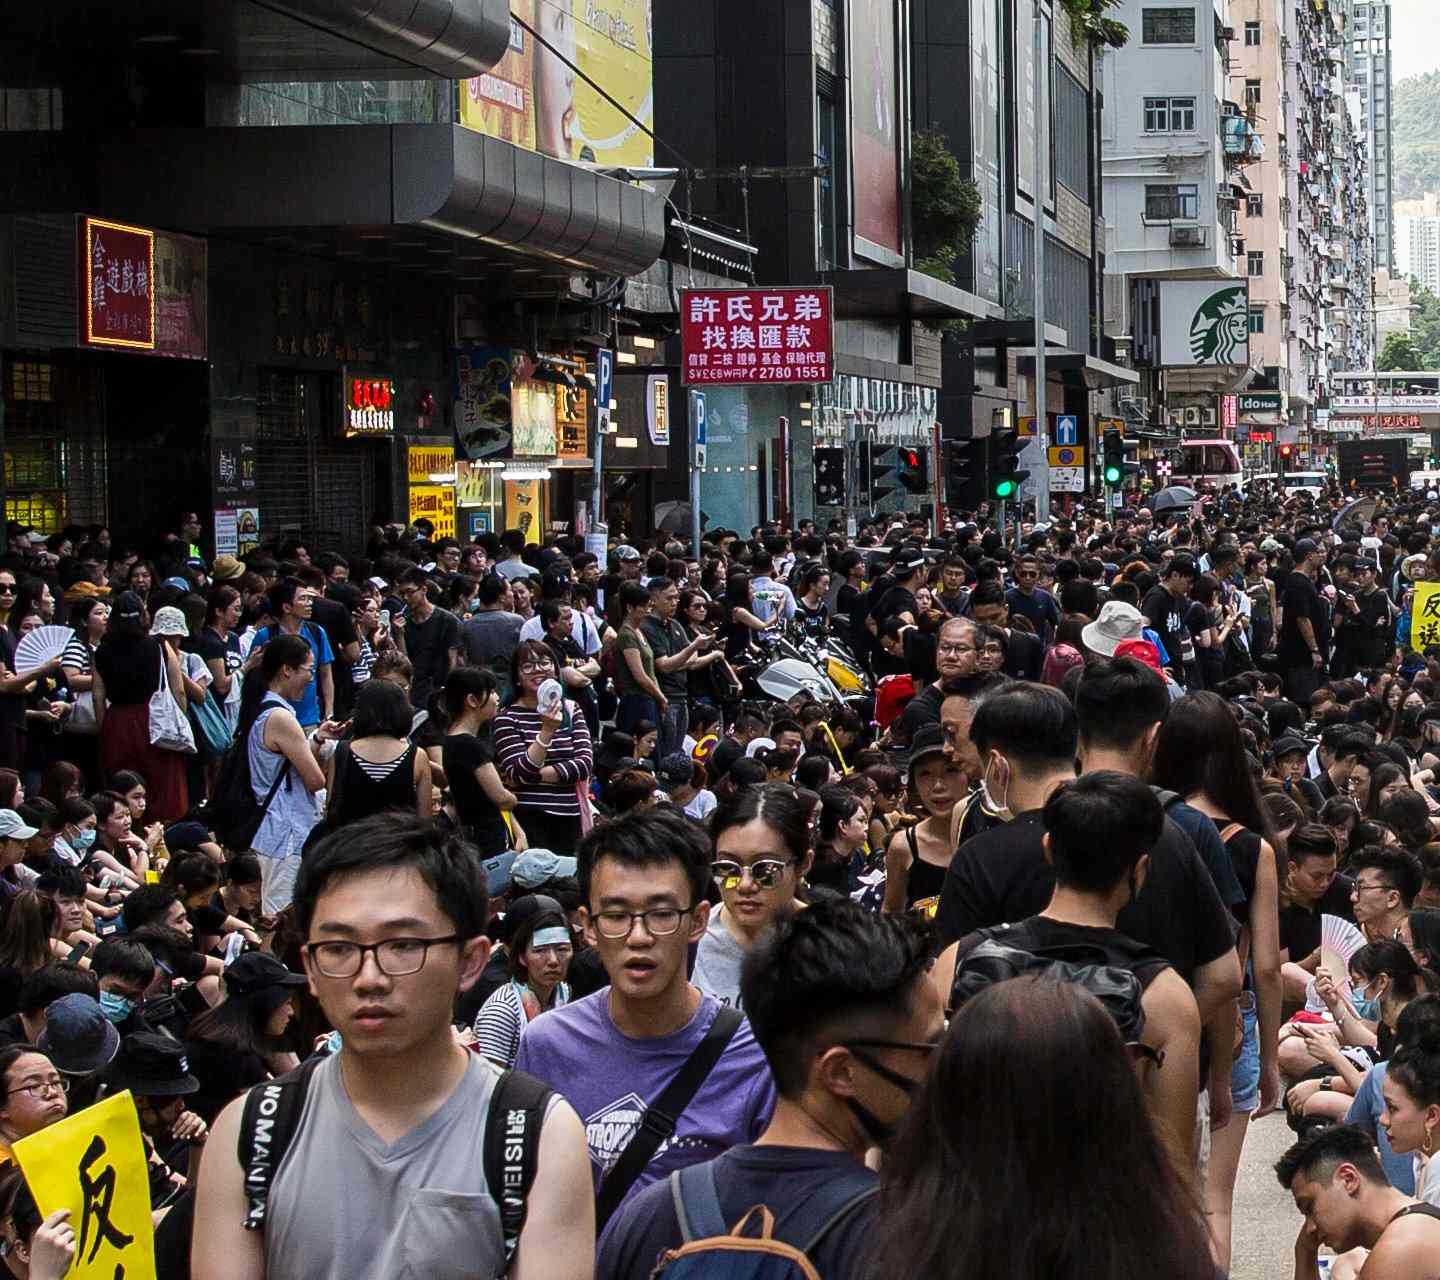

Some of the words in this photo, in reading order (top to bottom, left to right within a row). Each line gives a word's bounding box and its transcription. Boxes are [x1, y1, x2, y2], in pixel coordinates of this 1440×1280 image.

[690, 294, 822, 323] 許氏兄弟
[702, 324, 811, 350] 找換匯款
[600, 356, 610, 403] P
[760, 367, 791, 380] 2780
[796, 366, 826, 378] 1551
[697, 399, 705, 443] P
